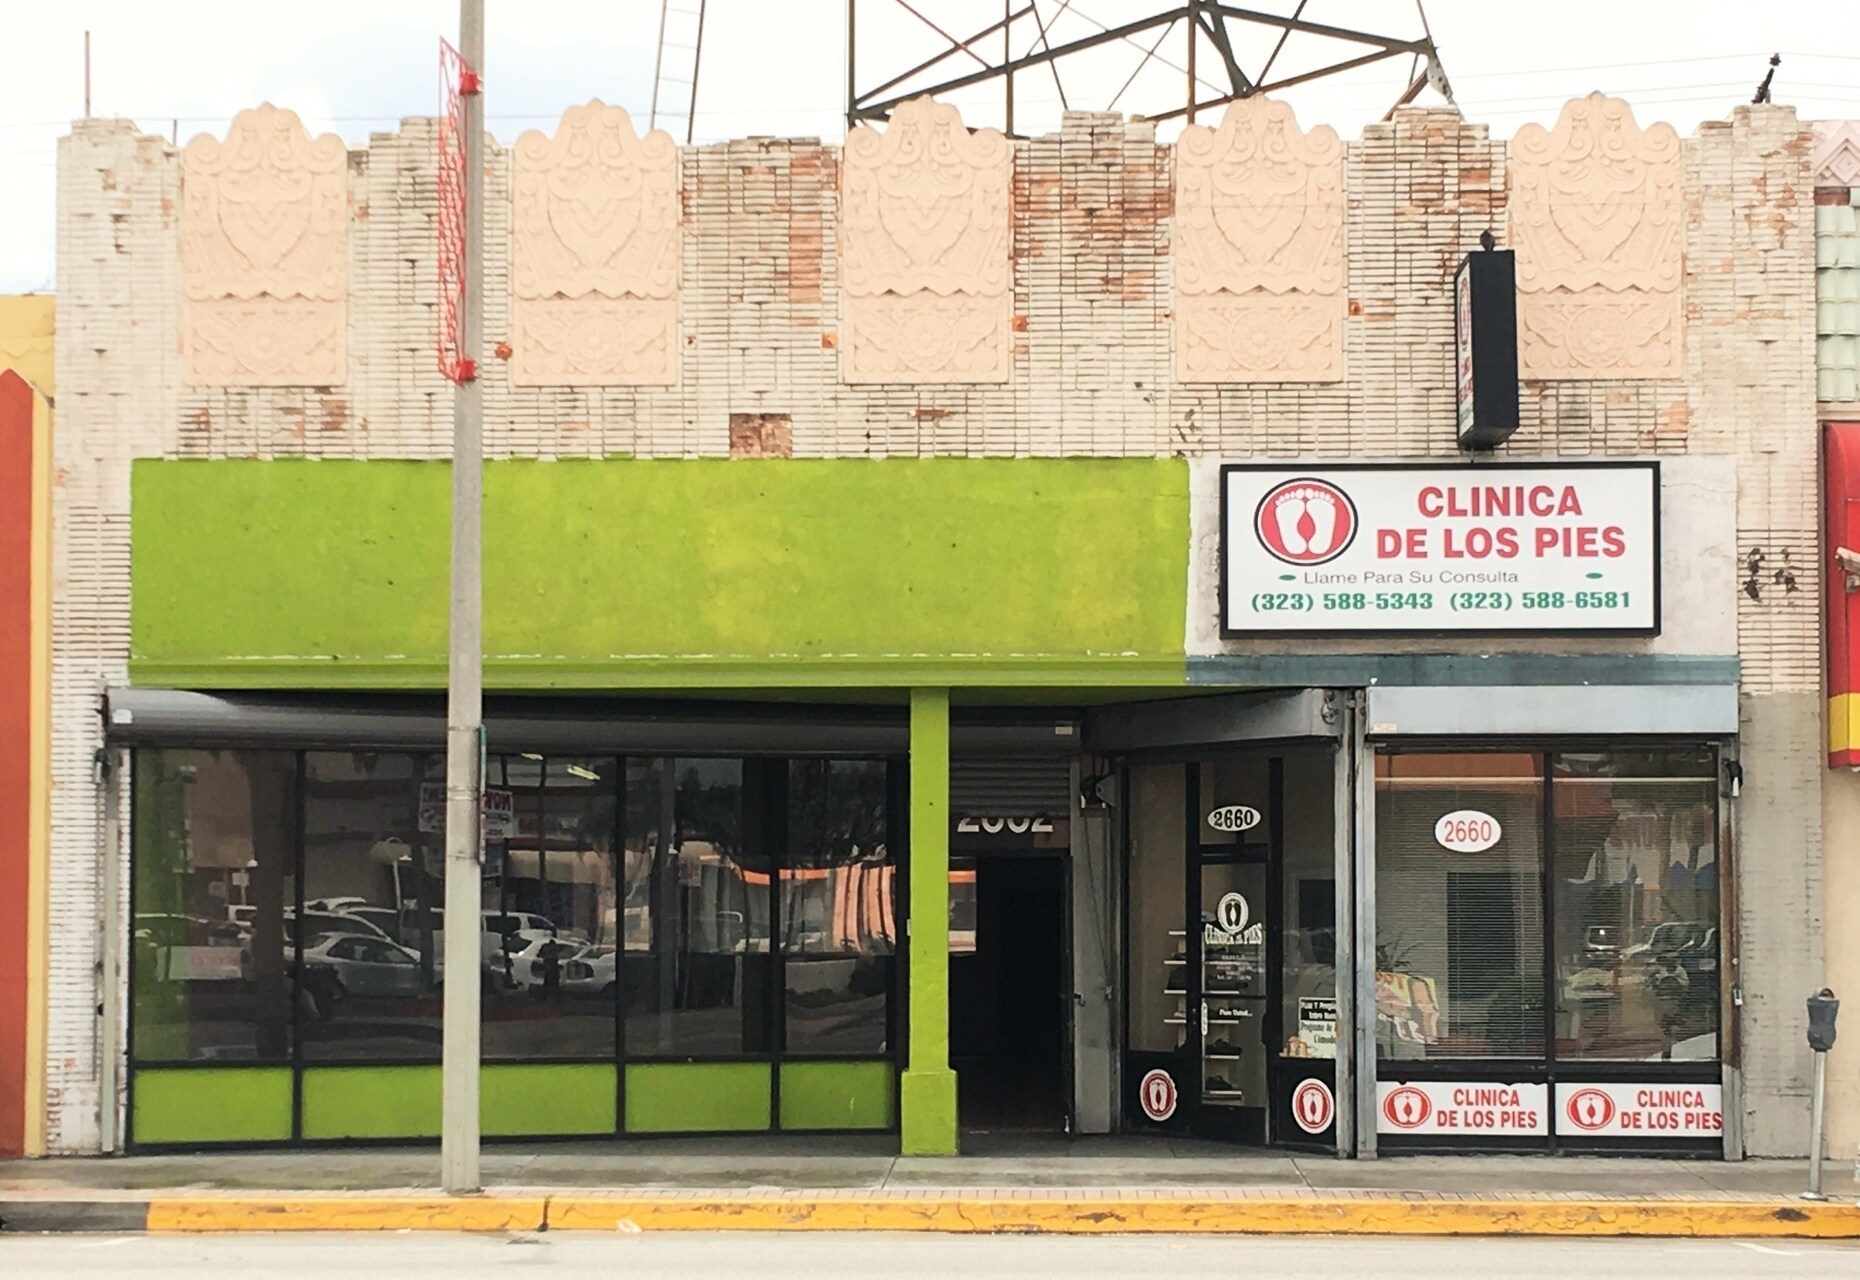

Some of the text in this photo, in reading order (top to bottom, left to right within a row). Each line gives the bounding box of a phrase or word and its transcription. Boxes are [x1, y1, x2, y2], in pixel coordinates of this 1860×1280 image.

[1417, 485, 1583, 518] CLINICA
[1376, 526, 1626, 560] DE LOS PIES
[1303, 570, 1519, 585] Llame Para Su Consulta
[1251, 591, 1631, 612] (323) 588-5343 (323) 588-6581
[1212, 810, 1255, 829] 2660
[1444, 820, 1492, 843] 2660
[1453, 1088, 1521, 1107] CLINICA
[1636, 1090, 1705, 1108] CLINICA
[1436, 1110, 1538, 1129] DE LOS PIES
[1620, 1111, 1722, 1130] DE LOS PIES
